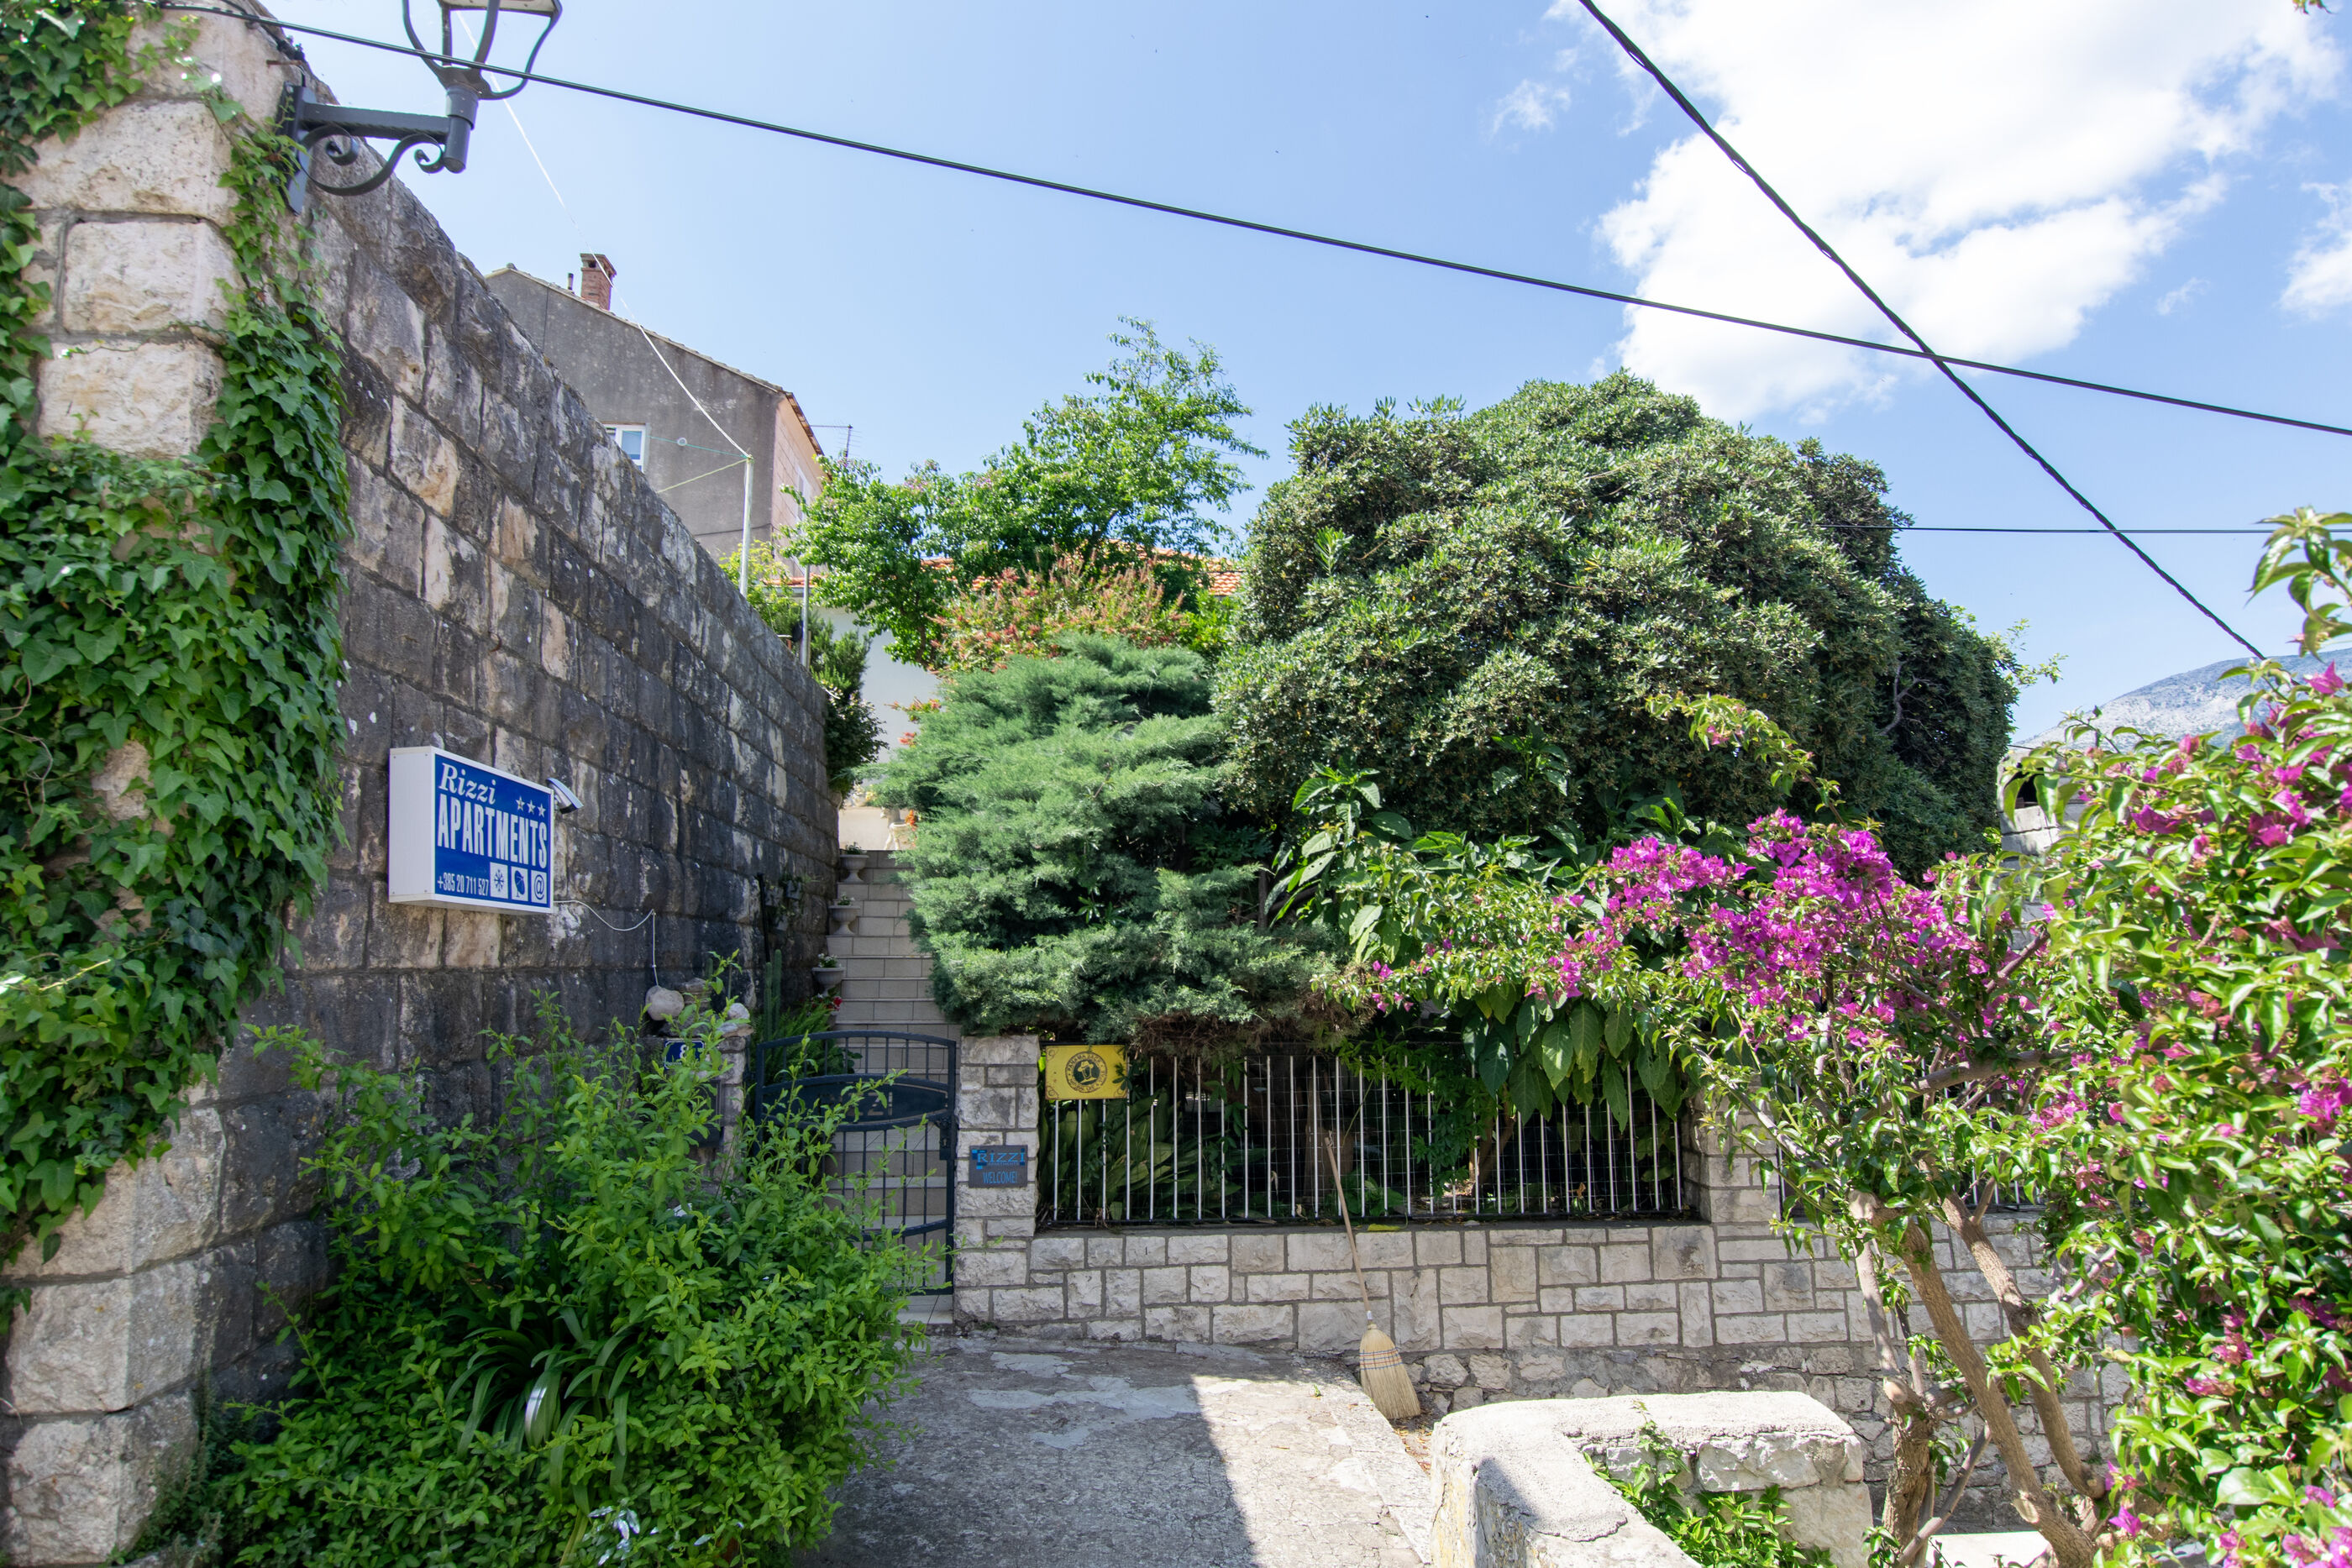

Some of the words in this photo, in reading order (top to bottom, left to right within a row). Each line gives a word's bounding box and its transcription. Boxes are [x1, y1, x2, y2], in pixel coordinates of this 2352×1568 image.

[438, 762, 496, 805] Rizzi
[437, 793, 548, 868] APARTMENTS
[437, 872, 455, 892] +385
[456, 874, 465, 893] 20
[465, 876, 476, 894] 711
[478, 878, 489, 896] 527
[983, 1171, 1018, 1183] WELCOME!
